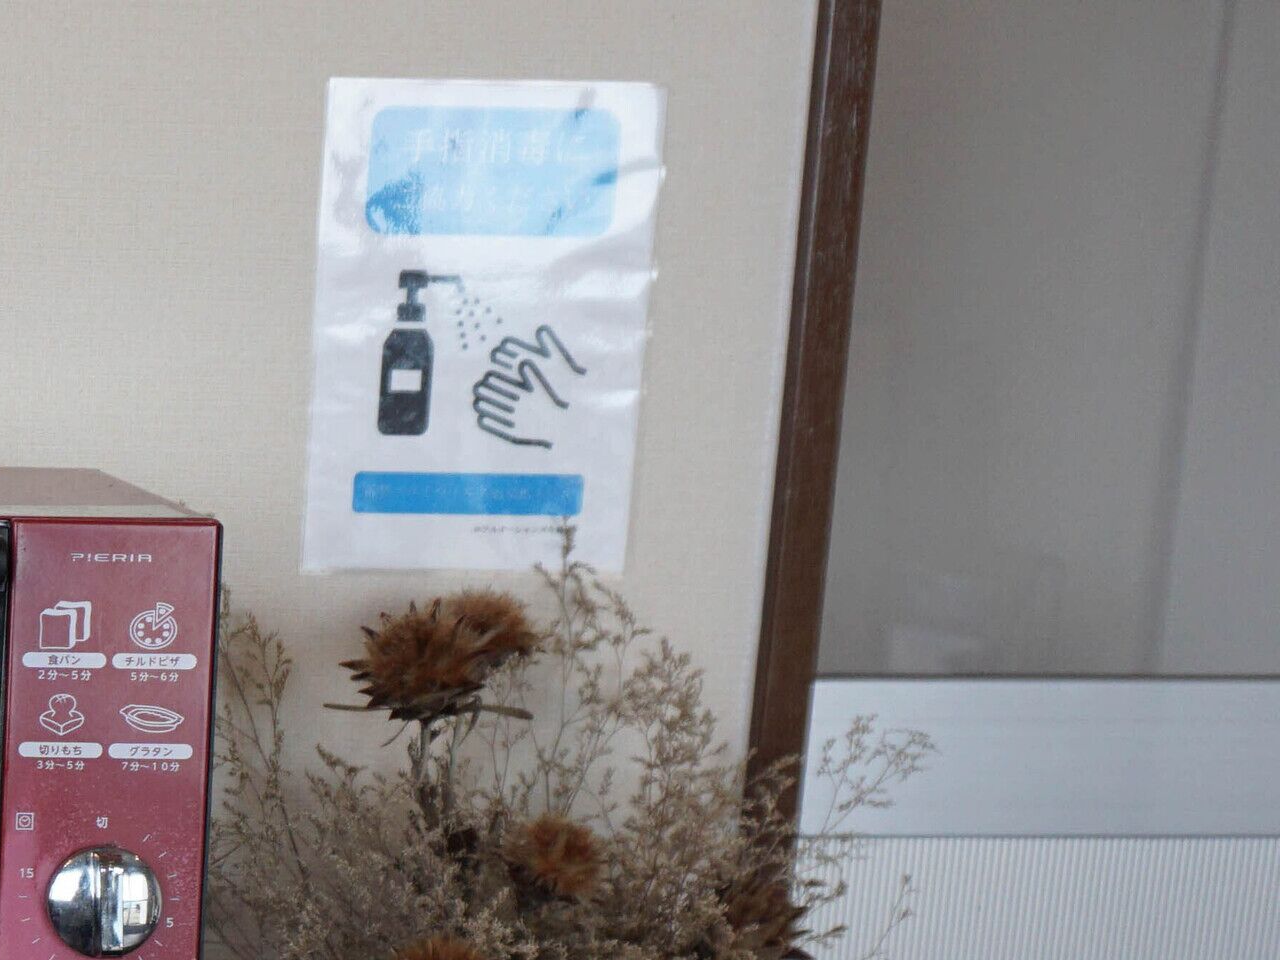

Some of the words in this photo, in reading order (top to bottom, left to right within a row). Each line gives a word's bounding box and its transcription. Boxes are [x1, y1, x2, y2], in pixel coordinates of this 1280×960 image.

[48, 655, 81, 666] 食パン
[125, 656, 180, 666] チルドピザ
[39, 745, 82, 756] 切りもち
[129, 747, 173, 757] グラタン
[96, 817, 109, 829] 切
[20, 868, 34, 878] 15
[166, 918, 174, 928] 5
